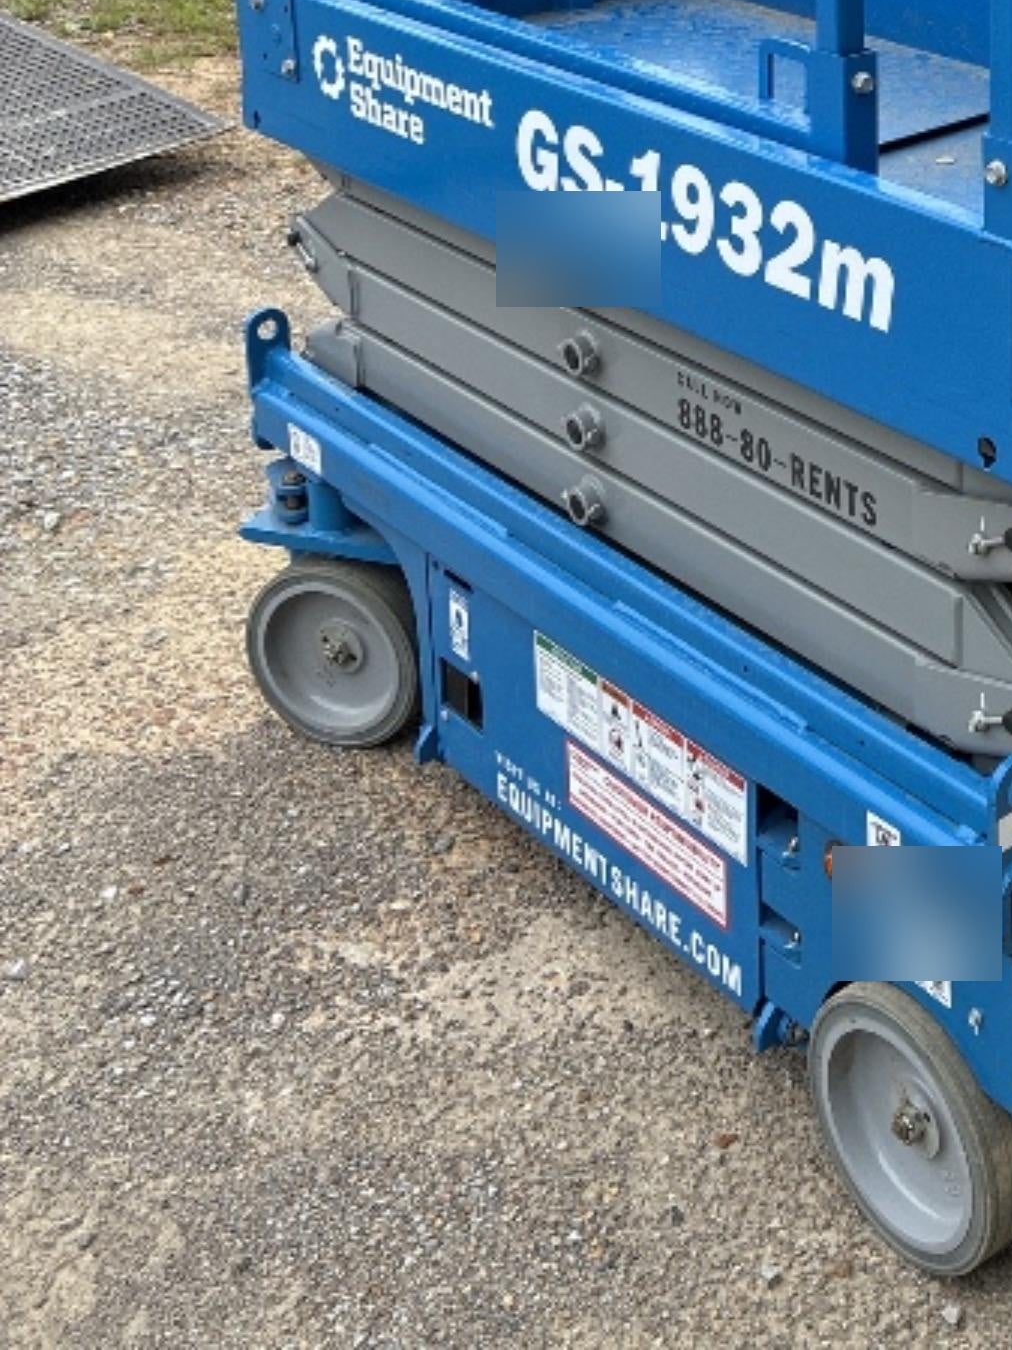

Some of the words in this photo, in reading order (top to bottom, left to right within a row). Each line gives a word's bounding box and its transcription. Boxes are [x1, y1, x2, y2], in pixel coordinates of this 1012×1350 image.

[346, 36, 495, 129] Equipment
[349, 85, 424, 145] Share
[678, 398, 878, 527] 888-80-RENTS
[497, 773, 742, 997] EQUIPMENTSHARE.COM
